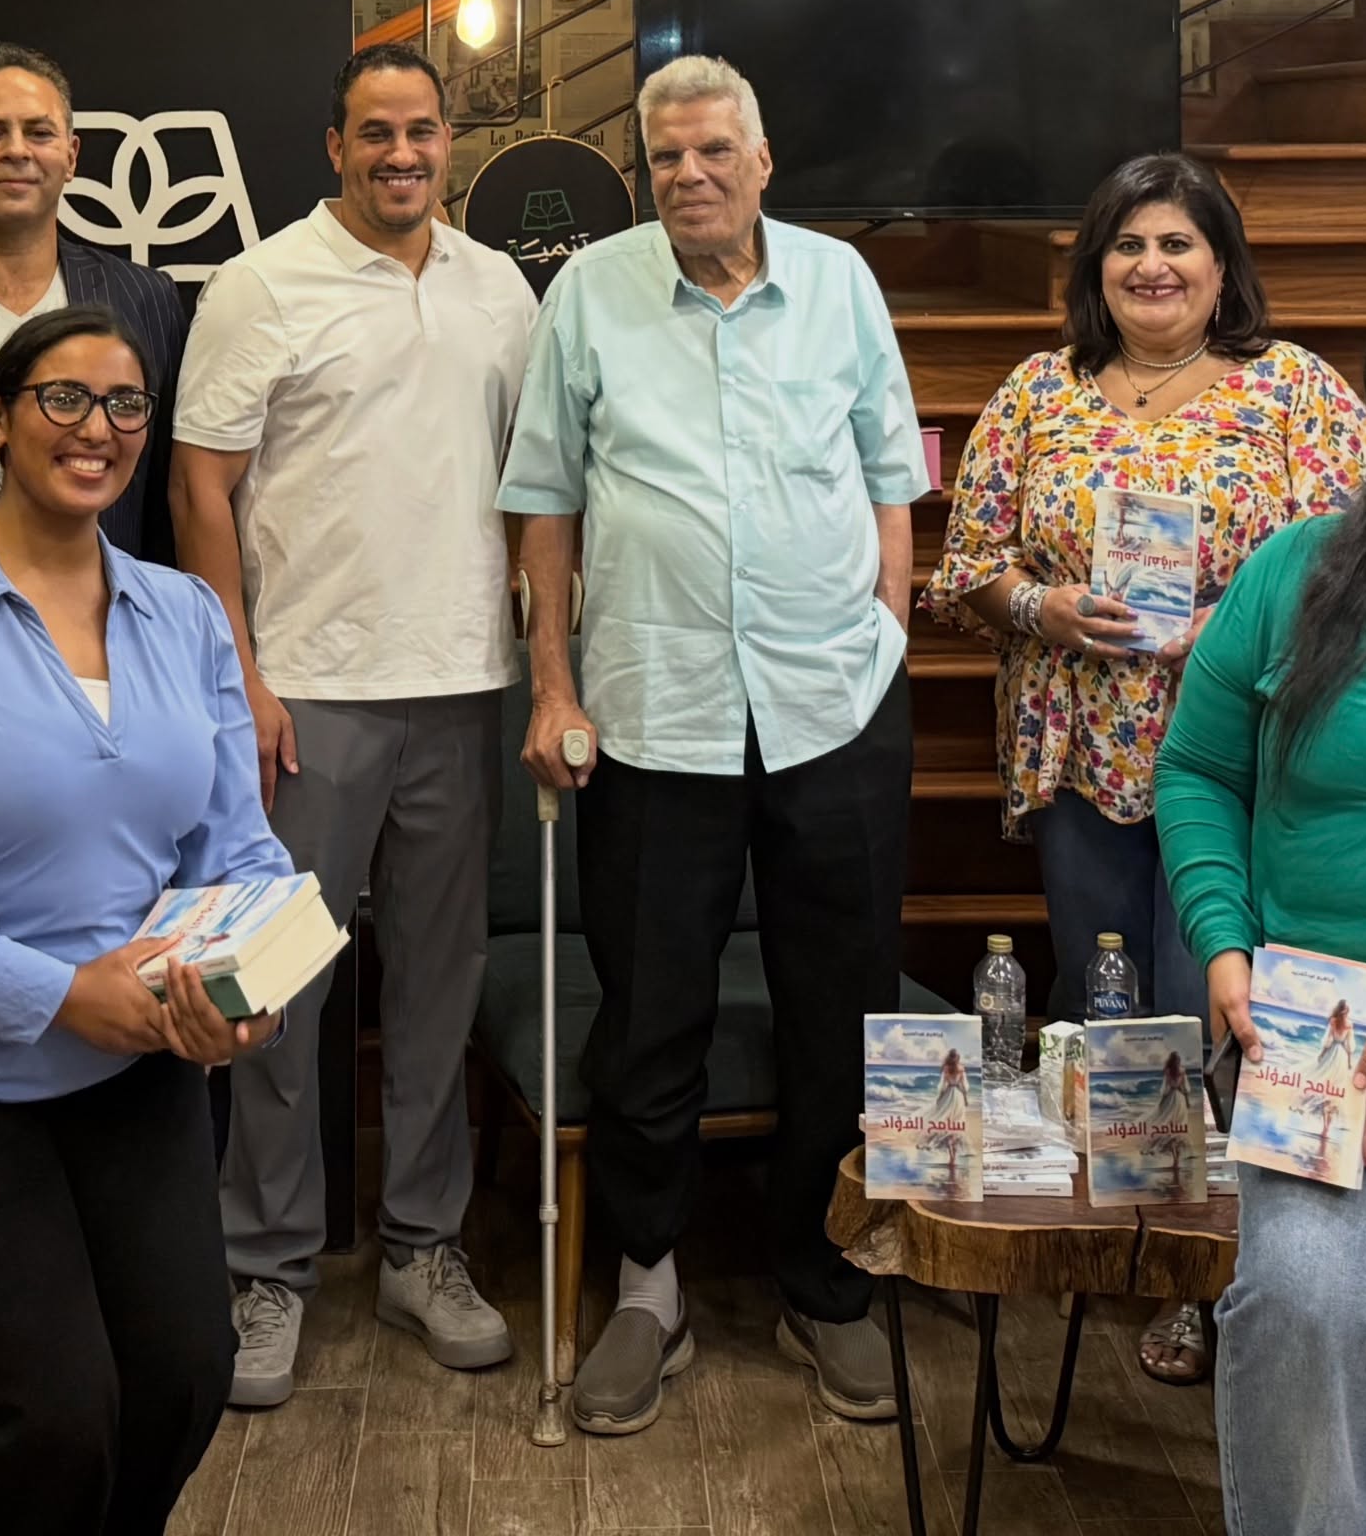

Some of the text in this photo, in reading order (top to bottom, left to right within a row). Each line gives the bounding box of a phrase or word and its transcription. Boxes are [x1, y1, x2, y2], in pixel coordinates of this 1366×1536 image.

[490, 130, 506, 146] Le
[507, 233, 590, 264] تنمية
[1107, 549, 1180, 571] سامح الفؤاد
[1255, 1066, 1346, 1098] سامح الفؤاد
[881, 1115, 966, 1133] سامح الفؤاد
[1106, 1121, 1188, 1139] سامح الفؤاد
